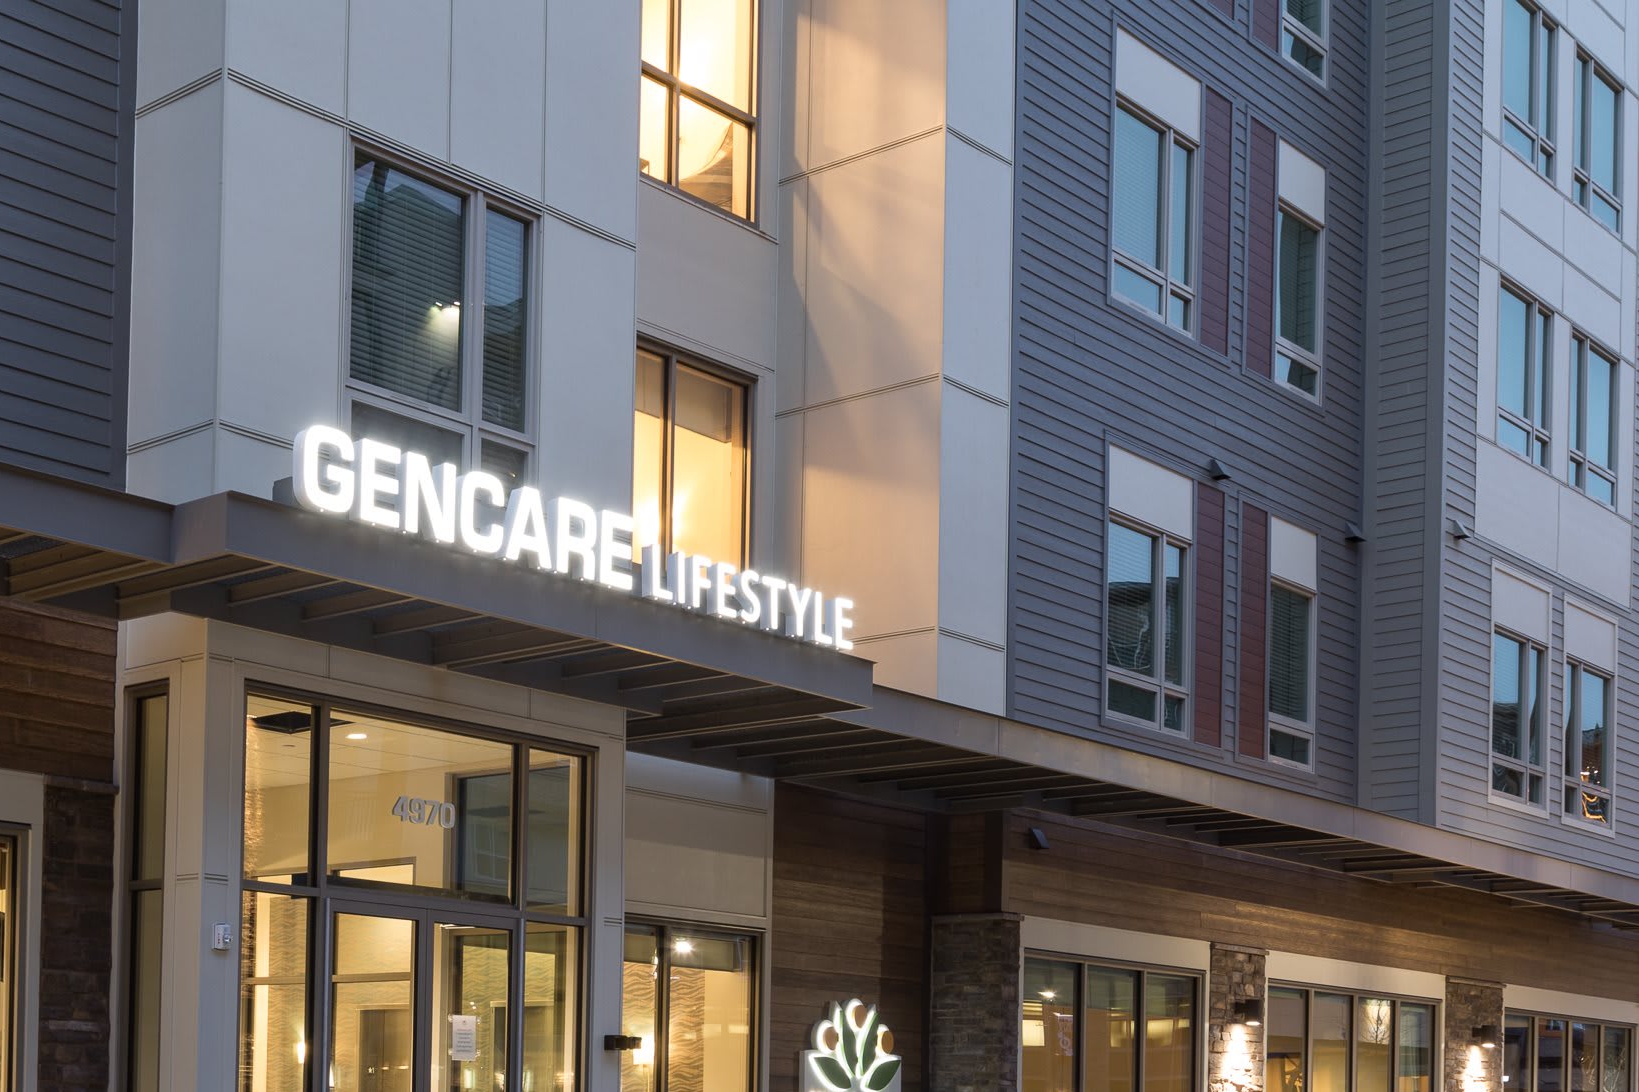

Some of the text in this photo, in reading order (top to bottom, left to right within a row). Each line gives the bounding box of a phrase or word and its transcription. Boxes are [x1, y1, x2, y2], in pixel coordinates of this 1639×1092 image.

[293, 424, 854, 650] GENCARE LIFESTYLE
[392, 796, 455, 828] 4970
